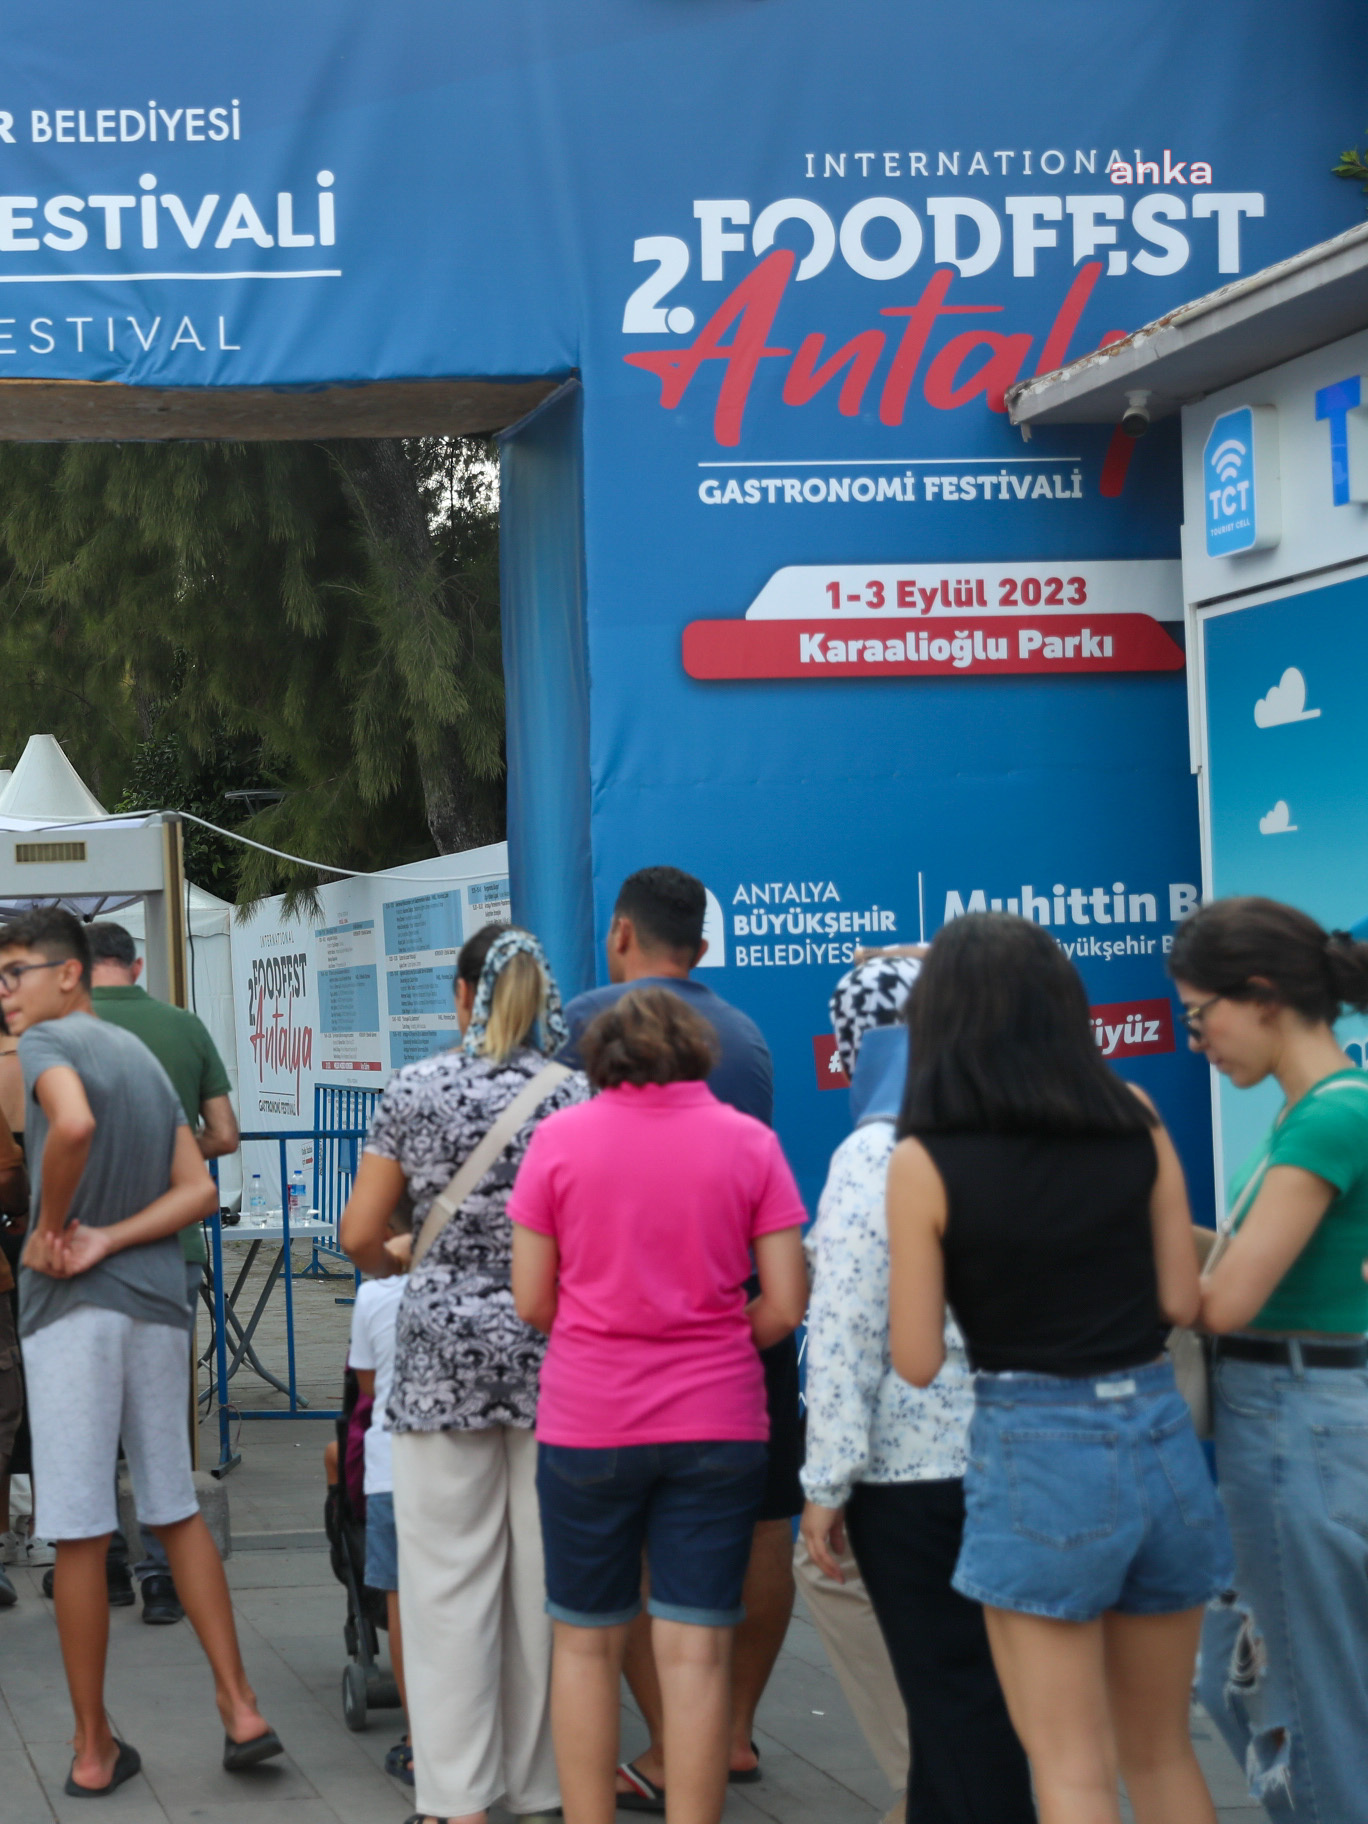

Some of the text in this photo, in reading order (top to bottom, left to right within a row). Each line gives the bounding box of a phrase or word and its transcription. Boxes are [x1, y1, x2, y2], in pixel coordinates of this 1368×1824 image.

[32, 99, 240, 142] BELEDİYESİ
[622, 192, 1265, 334] 2. FOODFEST
[698, 468, 1082, 504] GASTRONOMİ FESTİVALİ
[1209, 480, 1249, 520] TCT
[1210, 518, 1250, 536] TOURIST CELL
[825, 576, 1087, 615] 1-3 Eylül 2023
[799, 629, 1113, 667] Karaalioğlu Parkı
[732, 881, 840, 905] ANTALYA
[944, 882, 1157, 925] Muhittin
[259, 930, 294, 948] INTERNATIONAL
[734, 904, 896, 938] BÜYÜKŞEHİR
[252, 953, 307, 1000] FOODFEST
[250, 985, 313, 1116] Antalya
